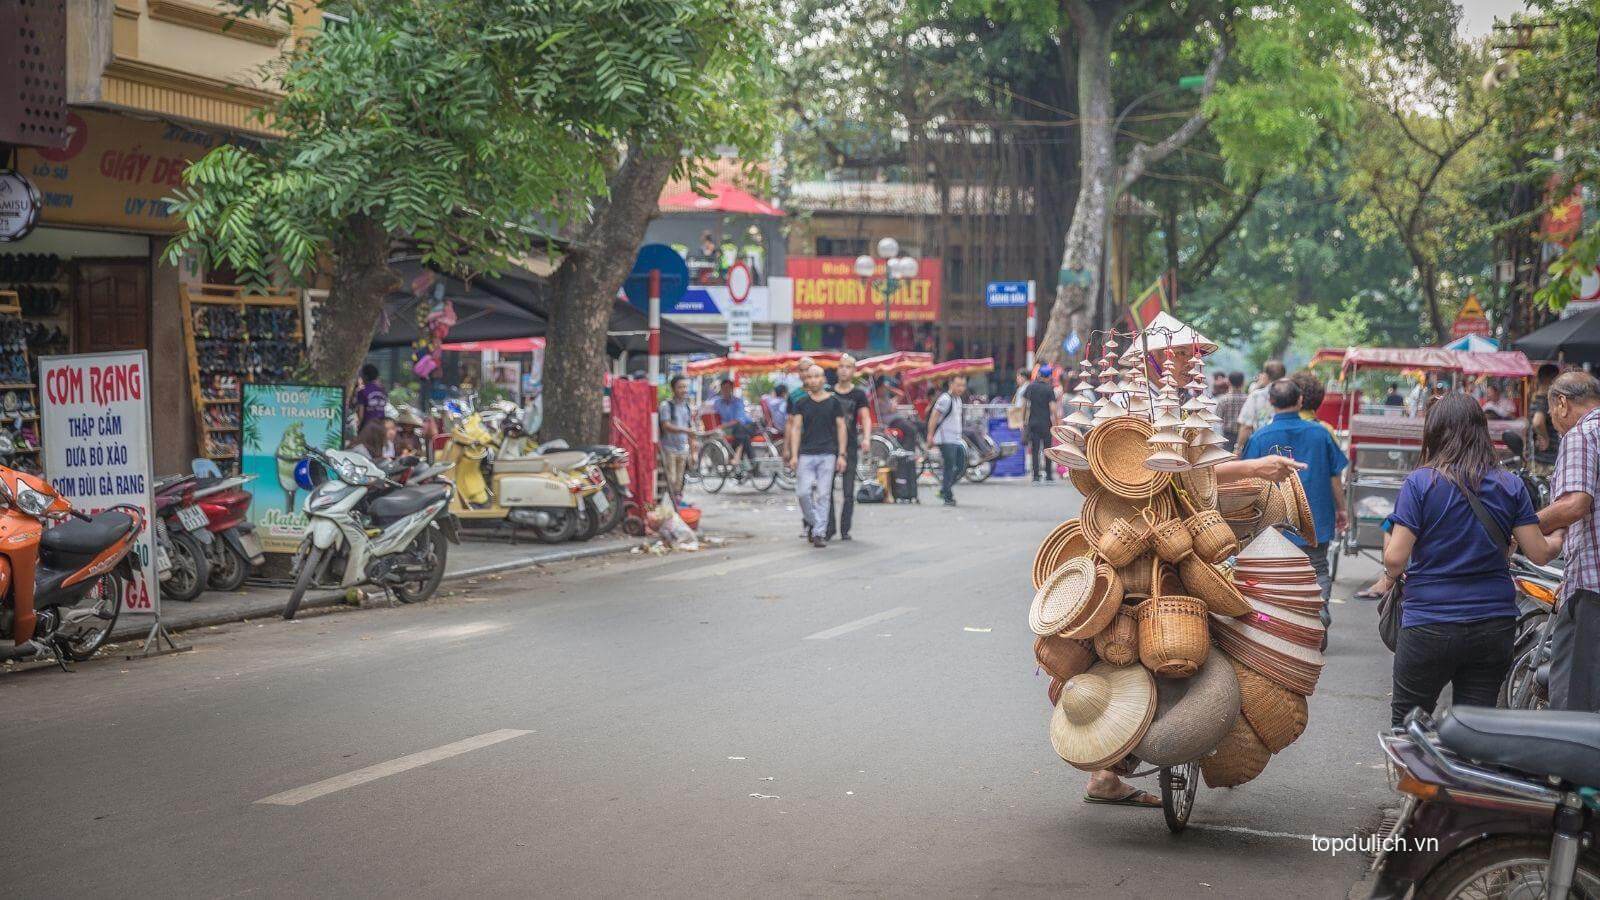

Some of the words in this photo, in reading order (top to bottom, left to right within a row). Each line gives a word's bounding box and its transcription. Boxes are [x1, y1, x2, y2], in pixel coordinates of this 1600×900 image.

[795, 278, 866, 306] FACTORY
[46, 365, 84, 406] CƠM
[89, 363, 141, 407] RANG
[276, 391, 311, 404] 100%
[250, 404, 276, 418] REAL
[281, 407, 335, 420] TIRAMISU
[65, 444, 87, 468] DƯA
[90, 441, 104, 467] BÒ
[106, 441, 128, 465] XÀO
[100, 472, 114, 496] GÀ
[116, 475, 144, 495] RANG
